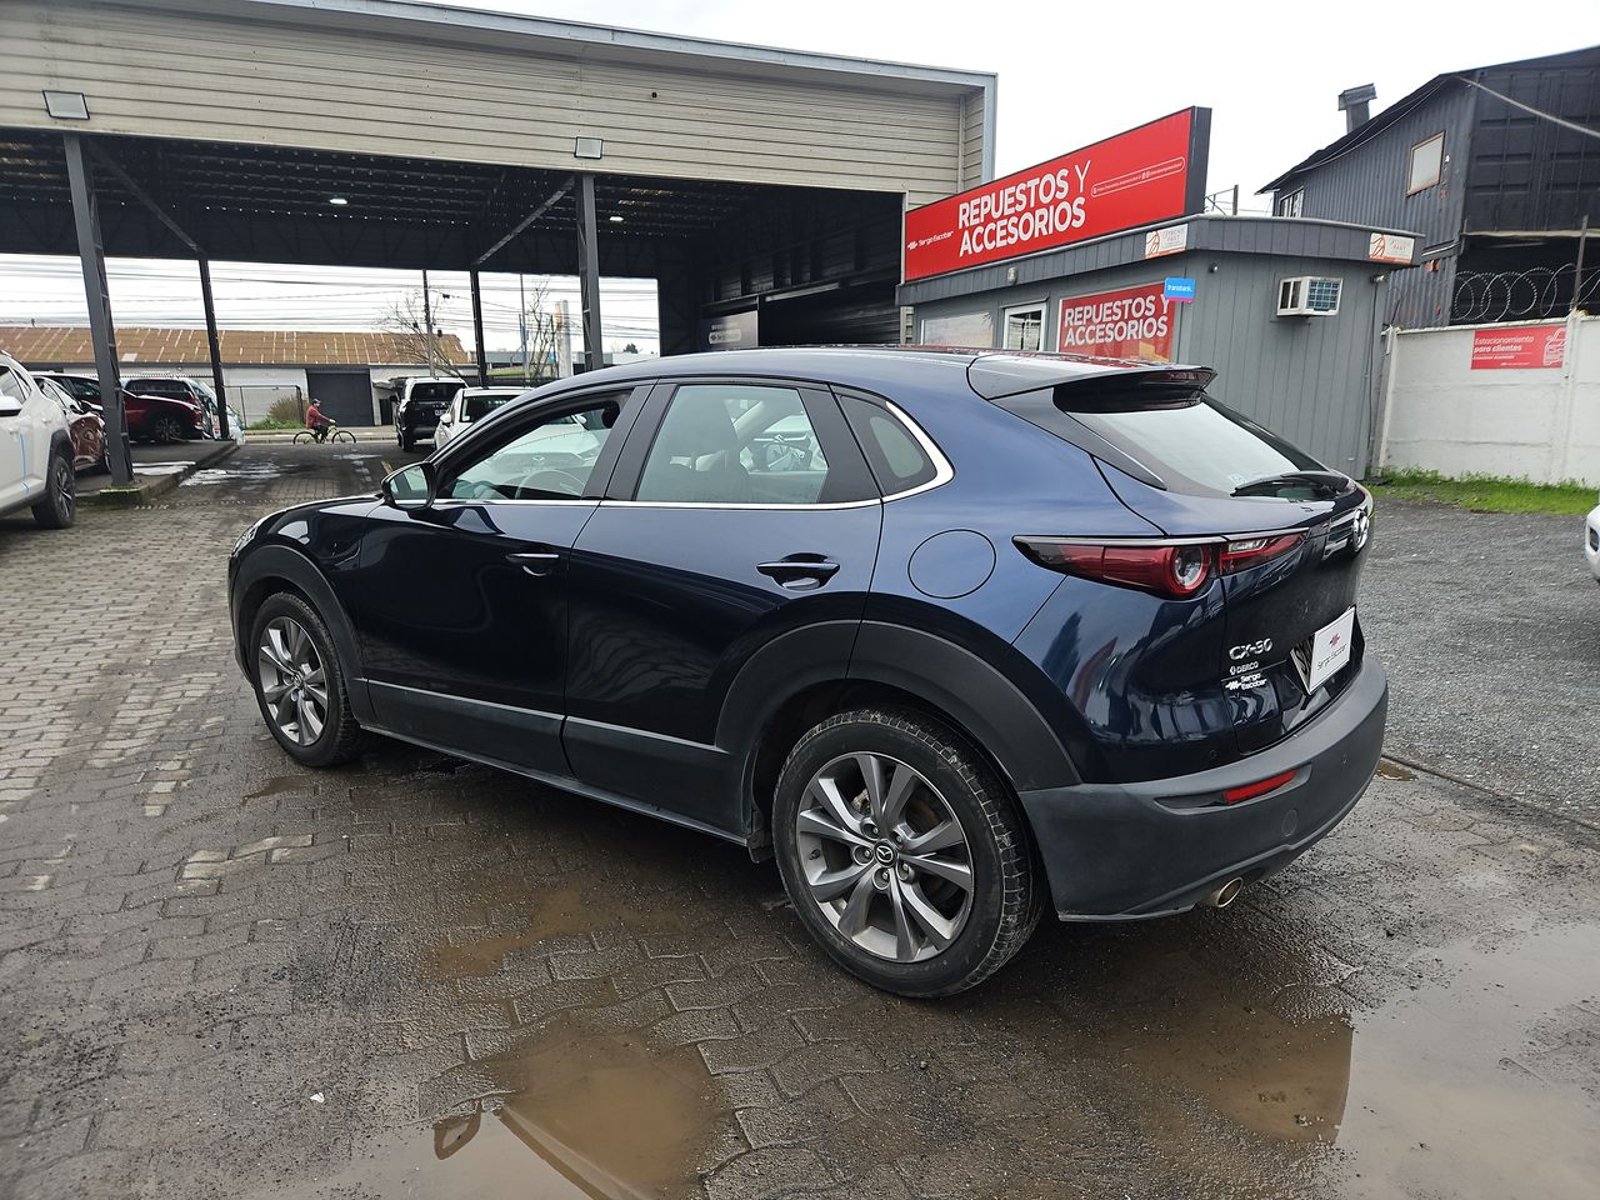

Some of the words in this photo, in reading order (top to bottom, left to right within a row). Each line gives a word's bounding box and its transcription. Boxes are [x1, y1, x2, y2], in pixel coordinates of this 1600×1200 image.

[958, 168, 1069, 230] REPUESTOS
[1074, 159, 1091, 193] Y
[959, 196, 1086, 257] ACCESORIOS
[1064, 296, 1156, 327] REPUESTOS
[1160, 293, 1170, 315] Y
[1064, 315, 1168, 347] ACCESORIOS
[1473, 346, 1492, 354] para
[1492, 344, 1522, 352] clientes
[1229, 638, 1273, 660] CX-30
